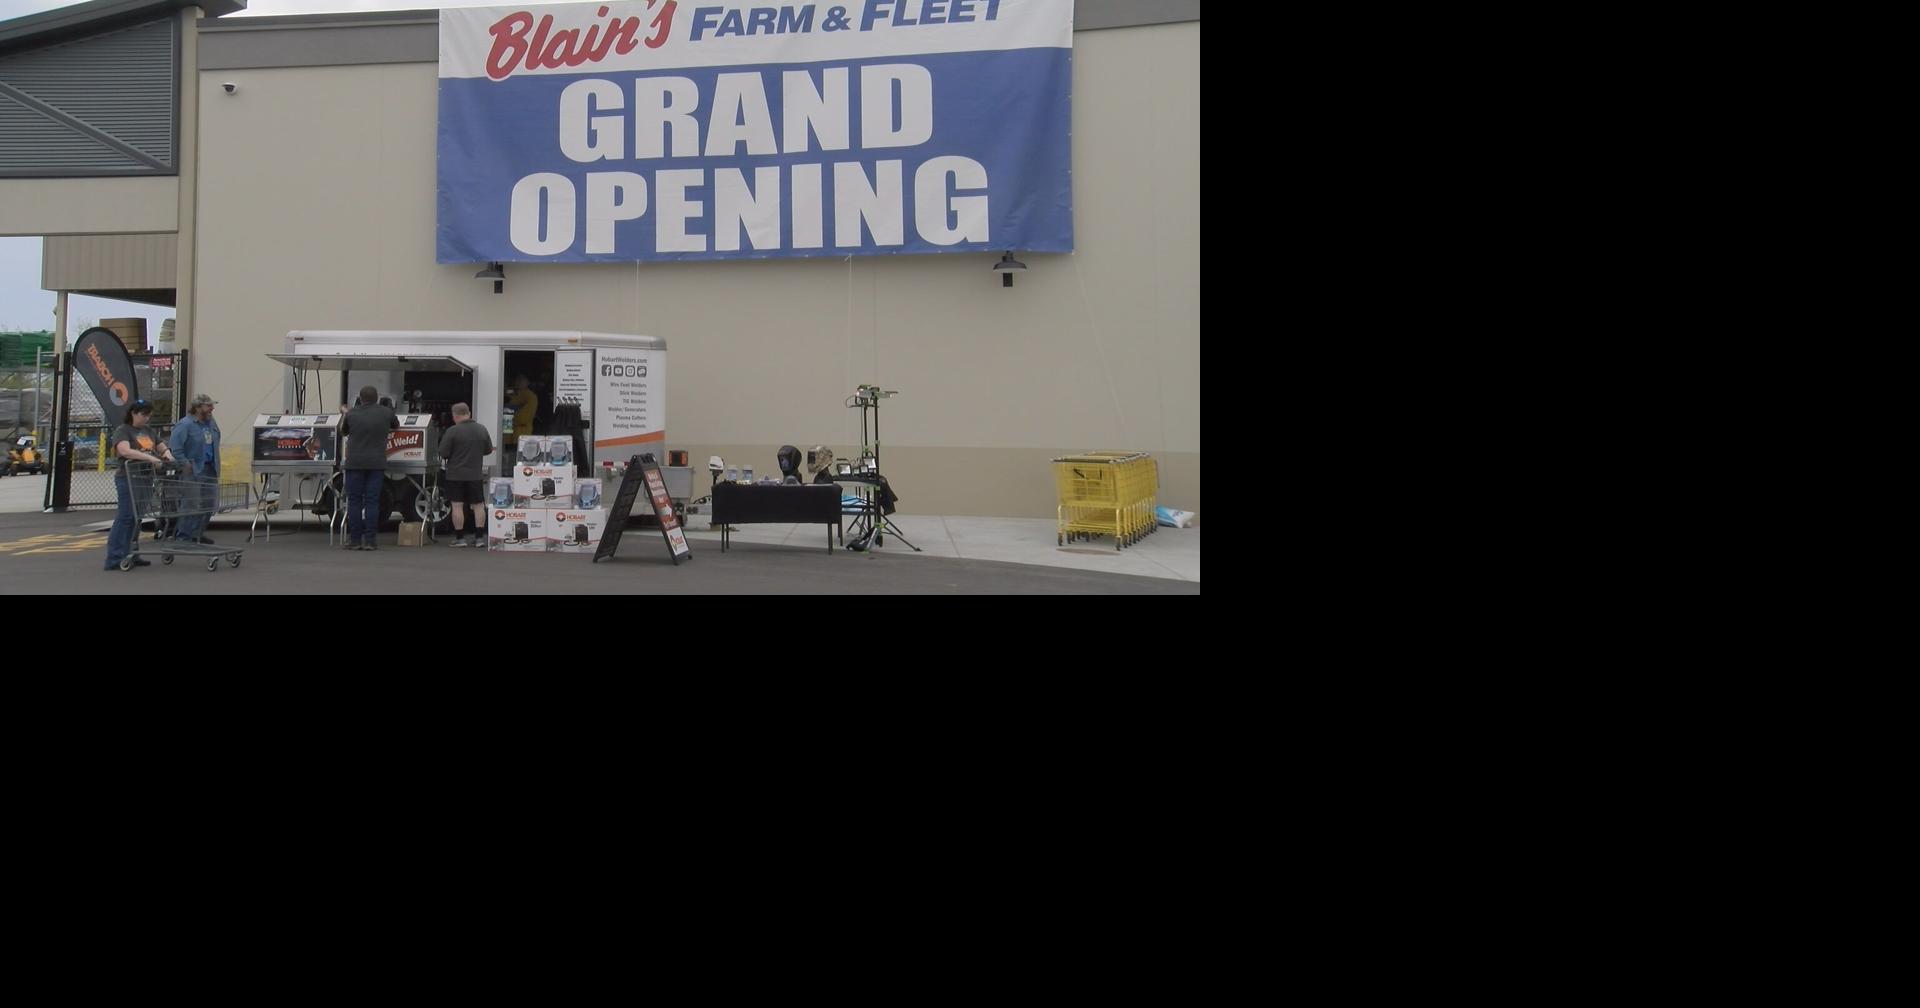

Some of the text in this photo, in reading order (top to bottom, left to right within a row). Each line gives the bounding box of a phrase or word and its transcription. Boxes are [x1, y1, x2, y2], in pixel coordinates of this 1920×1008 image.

[486, 0, 1000, 80] Blain's FARM & FLEET
[559, 63, 933, 163] GRAND
[510, 155, 990, 256] OPENING
[393, 434, 419, 447] Weld!
